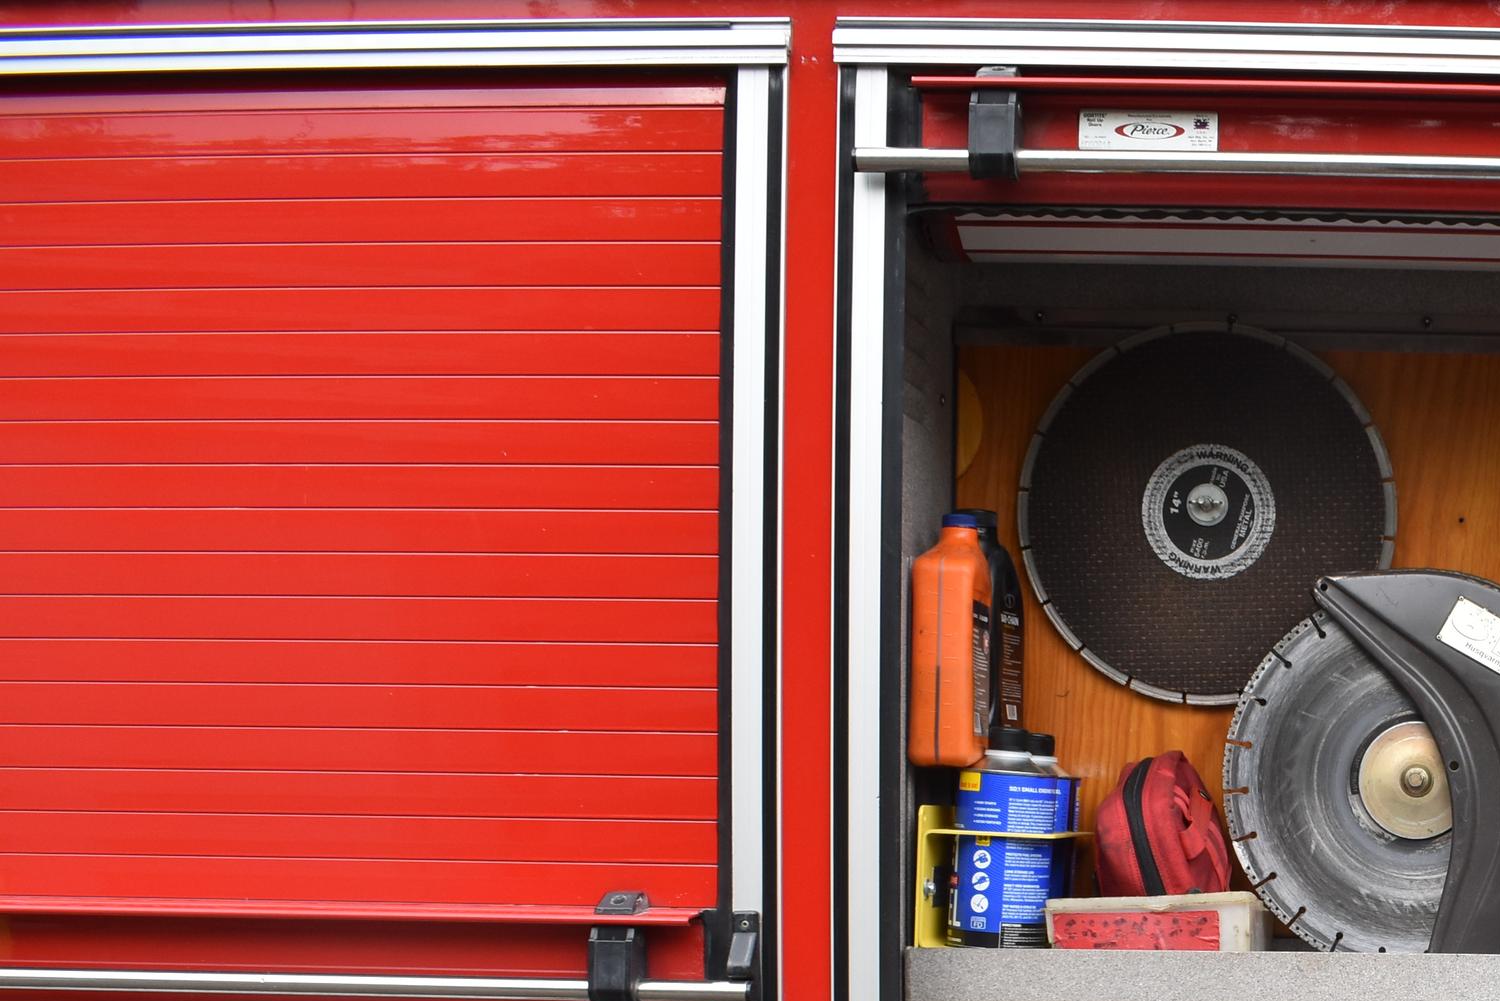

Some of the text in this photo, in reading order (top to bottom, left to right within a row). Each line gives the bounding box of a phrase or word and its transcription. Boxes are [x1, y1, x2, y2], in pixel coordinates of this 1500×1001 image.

[1131, 124, 1168, 136] Pierce
[1196, 450, 1250, 473] WARNING
[1168, 551, 1221, 575] WARNING
